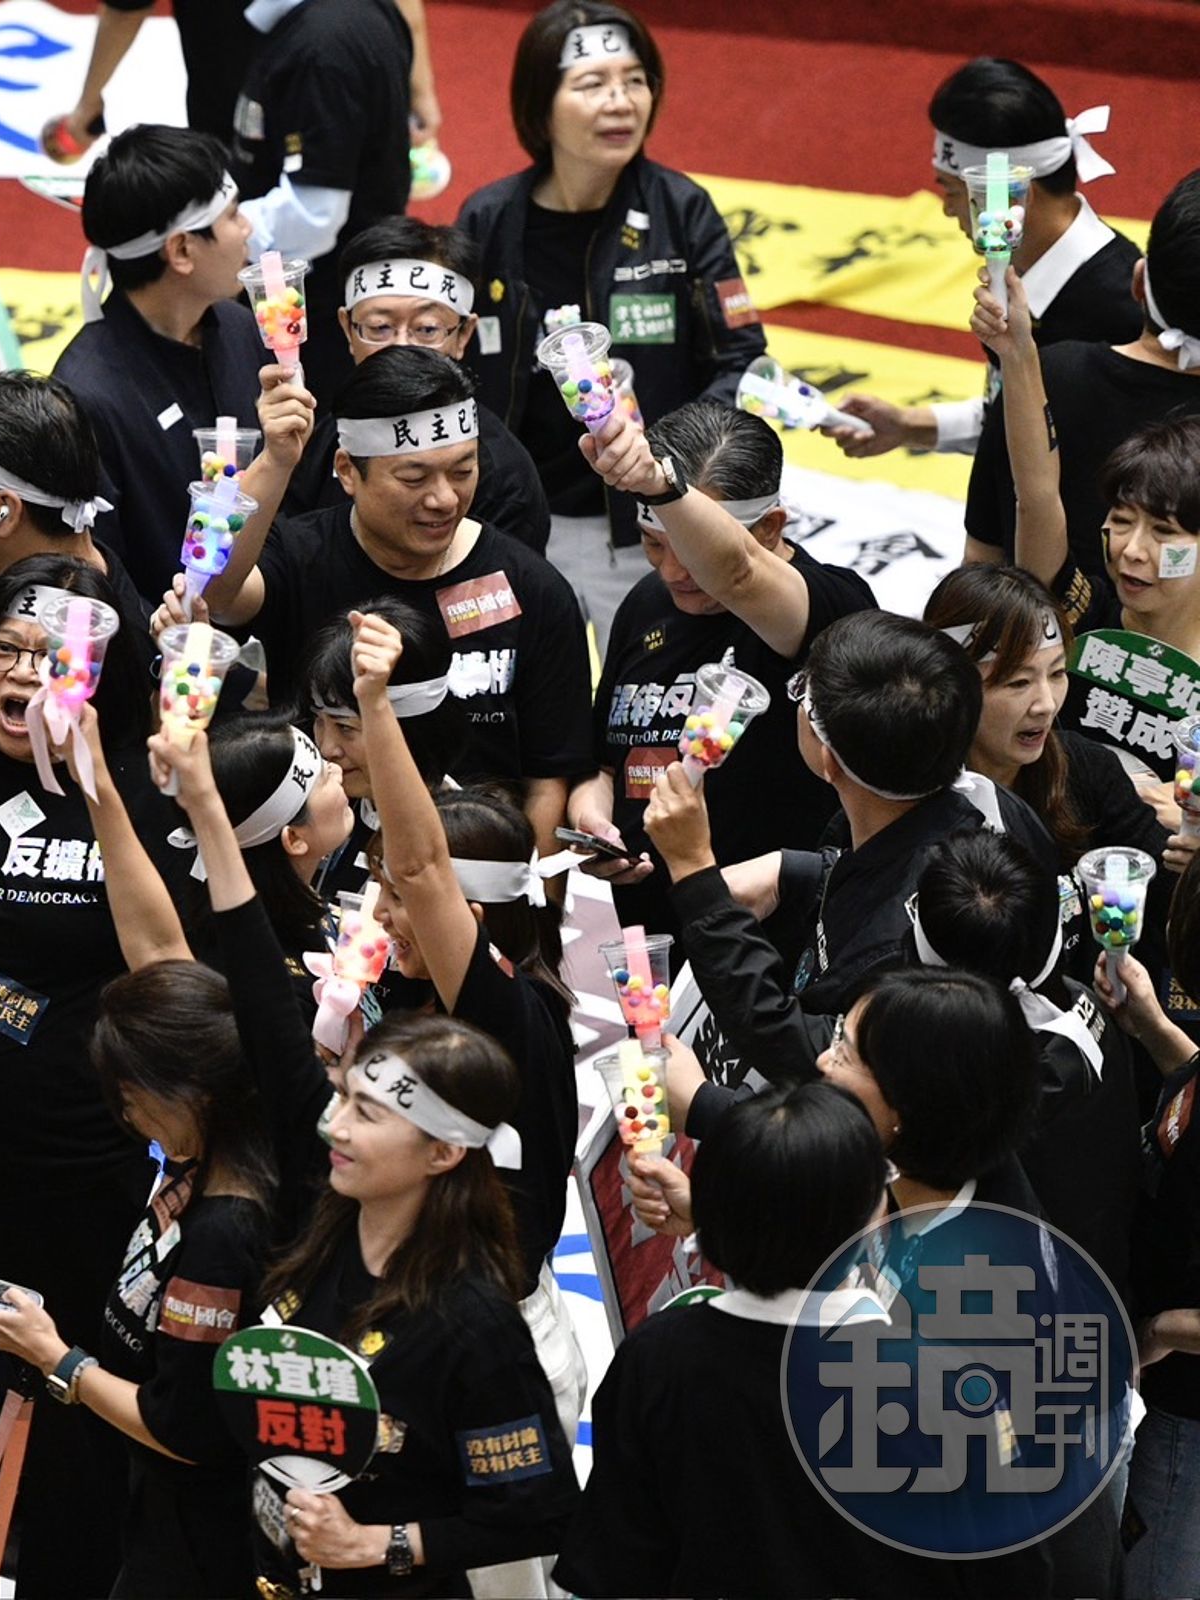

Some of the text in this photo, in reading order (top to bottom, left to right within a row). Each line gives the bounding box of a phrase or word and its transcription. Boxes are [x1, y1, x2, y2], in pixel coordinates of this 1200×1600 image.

[351, 263, 458, 304] 民主已死
[18, 588, 37, 617] 主
[226, 1345, 361, 1404] 林宜瑾
[256, 1400, 348, 1456] 反對
